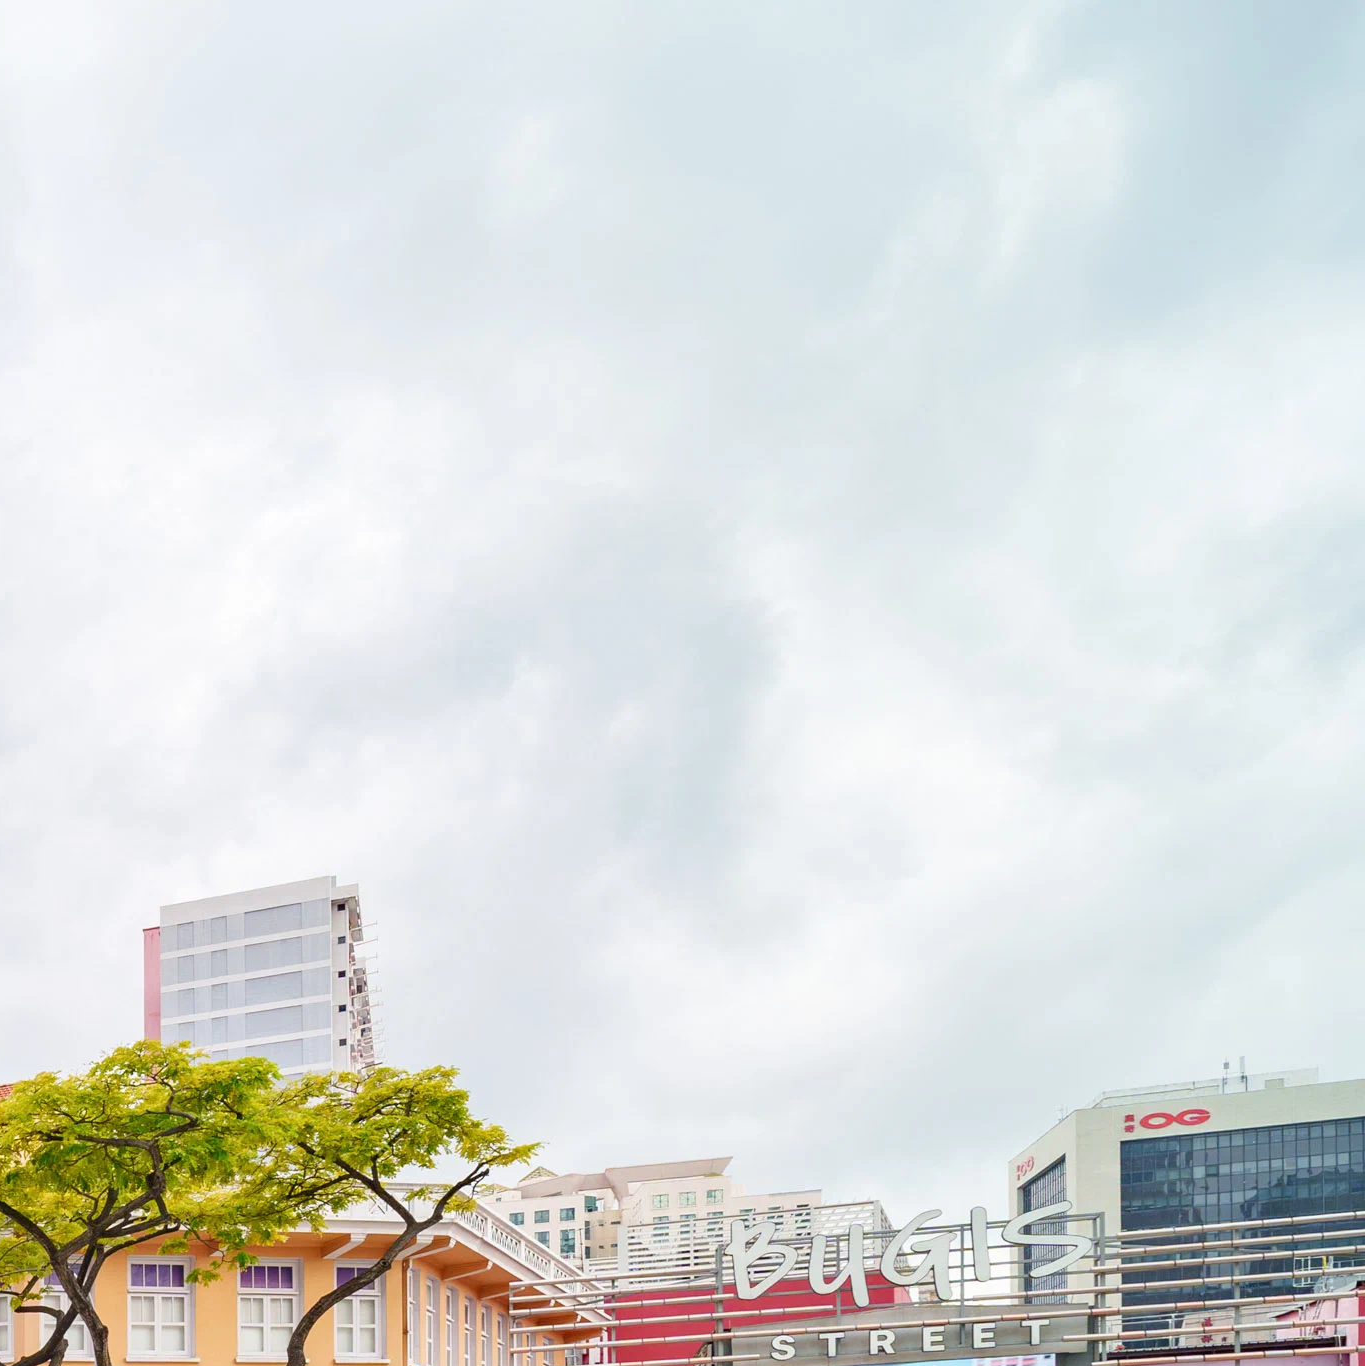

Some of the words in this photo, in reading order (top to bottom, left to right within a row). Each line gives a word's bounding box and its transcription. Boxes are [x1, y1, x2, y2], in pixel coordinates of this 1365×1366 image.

[1139, 1108, 1211, 1130] OG
[725, 1200, 1093, 1309] BUGIS
[771, 1319, 1050, 1361] STREET
